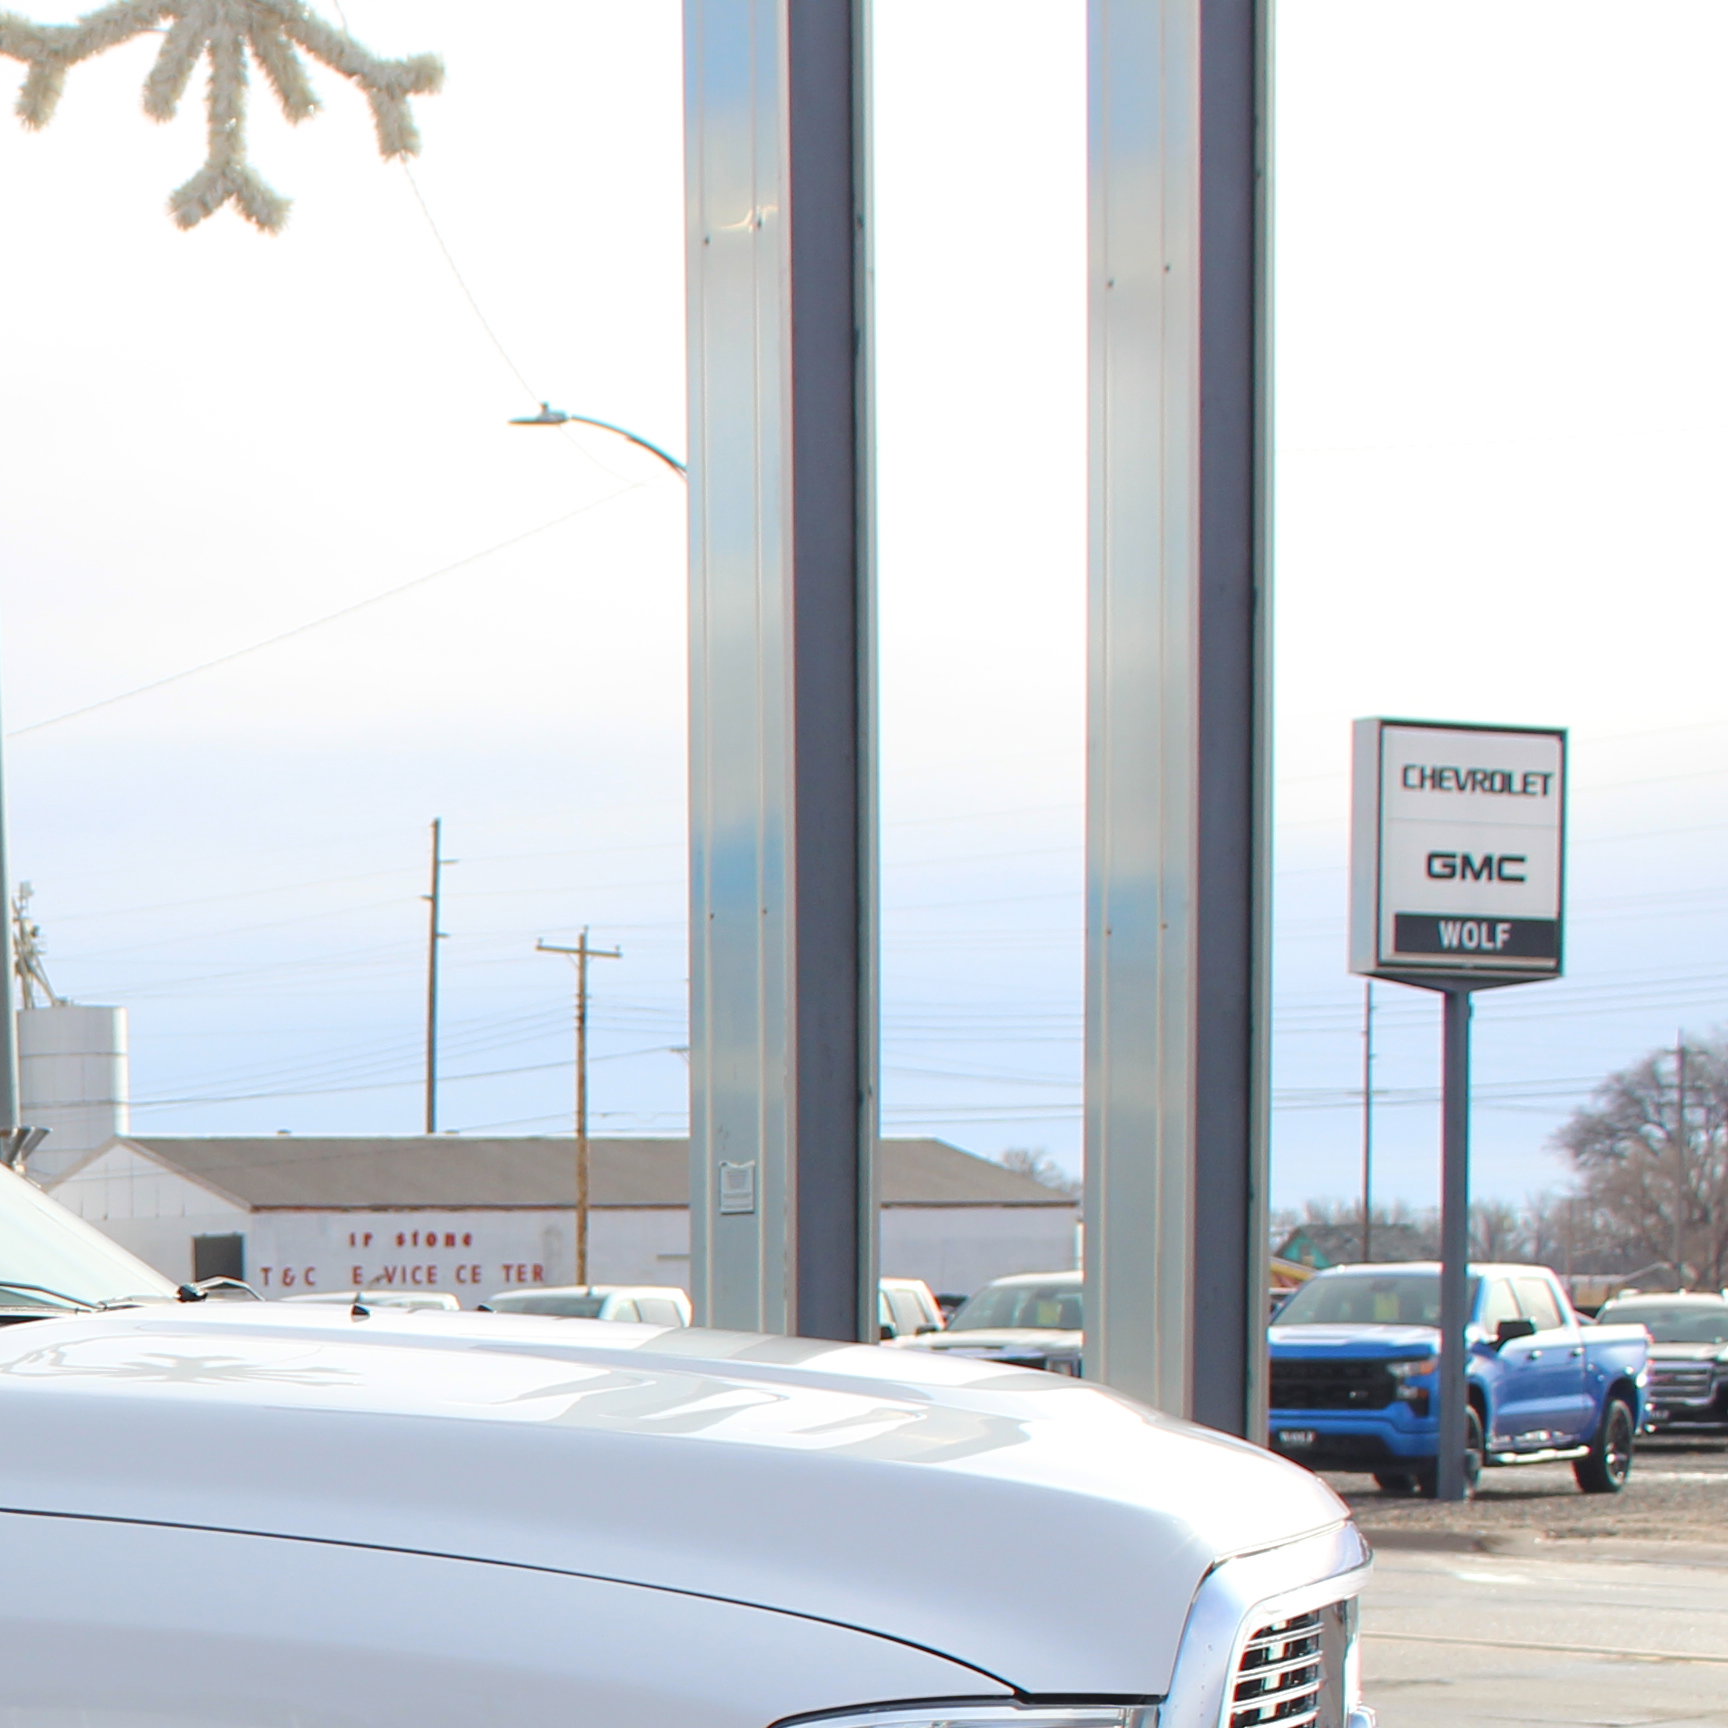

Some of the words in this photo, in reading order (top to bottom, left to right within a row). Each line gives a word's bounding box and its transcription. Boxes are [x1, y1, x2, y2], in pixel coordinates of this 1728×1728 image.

[1401, 764, 1554, 797] CHEVROLET
[1426, 852, 1527, 883] GMC
[1438, 919, 1512, 949] WOLF
